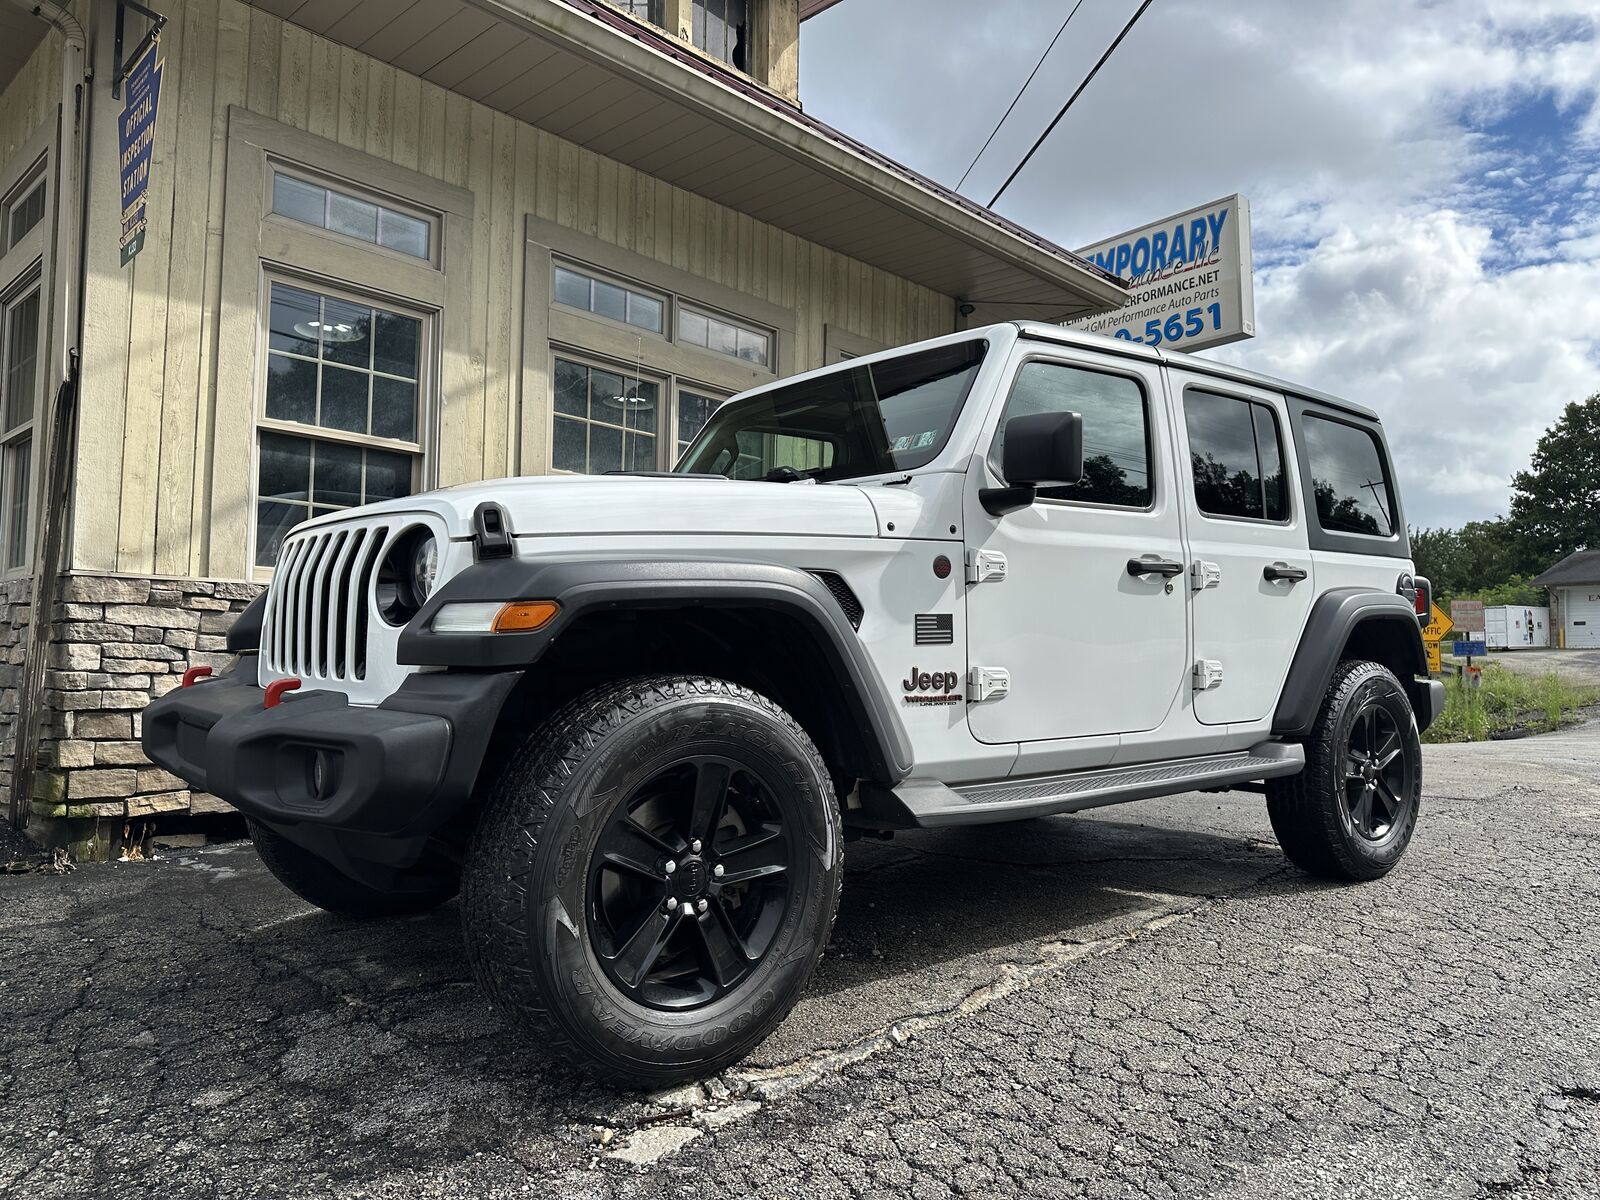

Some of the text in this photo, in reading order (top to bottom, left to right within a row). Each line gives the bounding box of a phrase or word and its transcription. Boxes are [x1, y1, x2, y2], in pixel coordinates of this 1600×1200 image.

[126, 93, 152, 137] OFFICIAL
[121, 121, 154, 172] INSPECTION
[124, 157, 148, 198] STATION
[1091, 319, 1106, 332] GM
[1108, 303, 1166, 328] Performance
[1168, 297, 1191, 310] Auto
[1194, 287, 1219, 303] Parts
[903, 666, 958, 695] Jeep
[571, 968, 775, 1053] GOODYEAR
